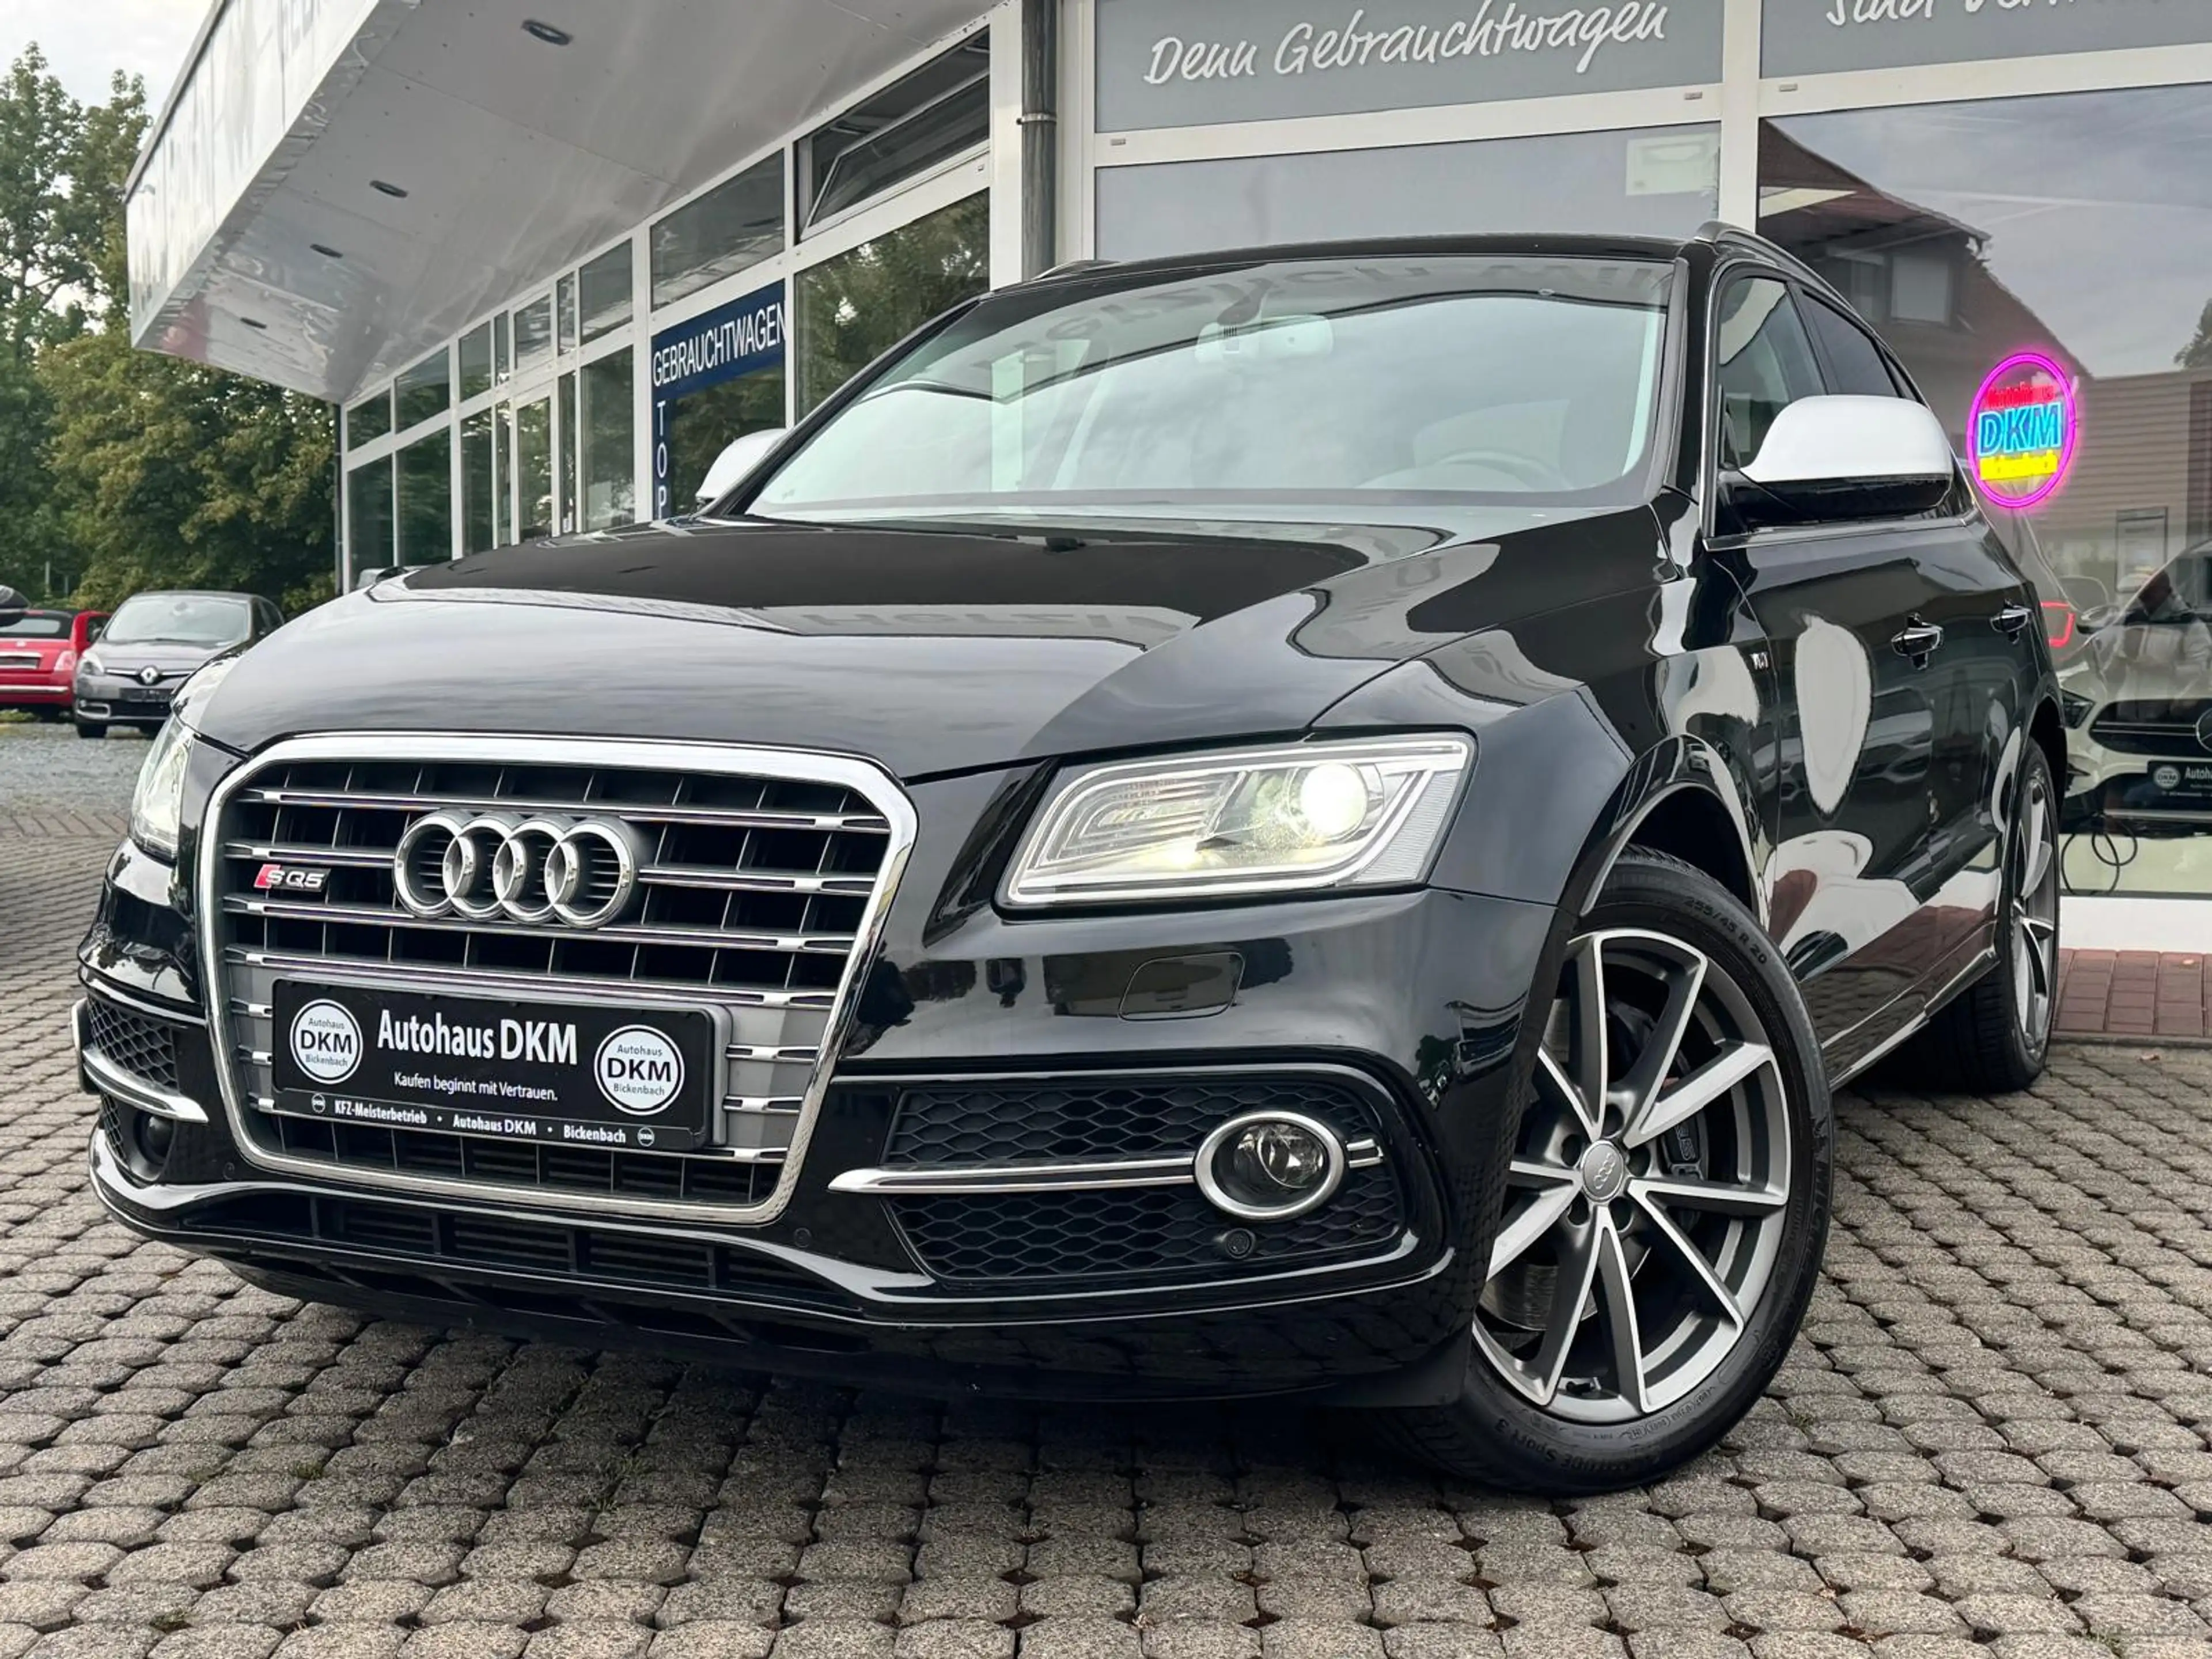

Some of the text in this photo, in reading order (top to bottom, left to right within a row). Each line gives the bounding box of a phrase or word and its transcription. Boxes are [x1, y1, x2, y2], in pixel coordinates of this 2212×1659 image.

[1143, 0, 1668, 84] Denn Gebrauchtwagen
[1978, 402, 2062, 456] DKM
[264, 869, 325, 888] SQ5
[308, 1018, 344, 1029] Autohaus
[301, 1029, 352, 1055] DKM
[377, 1009, 577, 1065] Autohaus DKM
[617, 1044, 662, 1056] Autohaus
[608, 1058, 671, 1082] DKM
[394, 1071, 558, 1101] Kaufen beginnt mit Vertrauen.
[613, 1083, 665, 1096] Bickenbach
[334, 1100, 427, 1124] KFZ-Meisterbetrieb
[453, 1114, 502, 1132] Autohaus
[504, 1119, 536, 1135] DKM
[563, 1125, 626, 1143] Bickenbach
